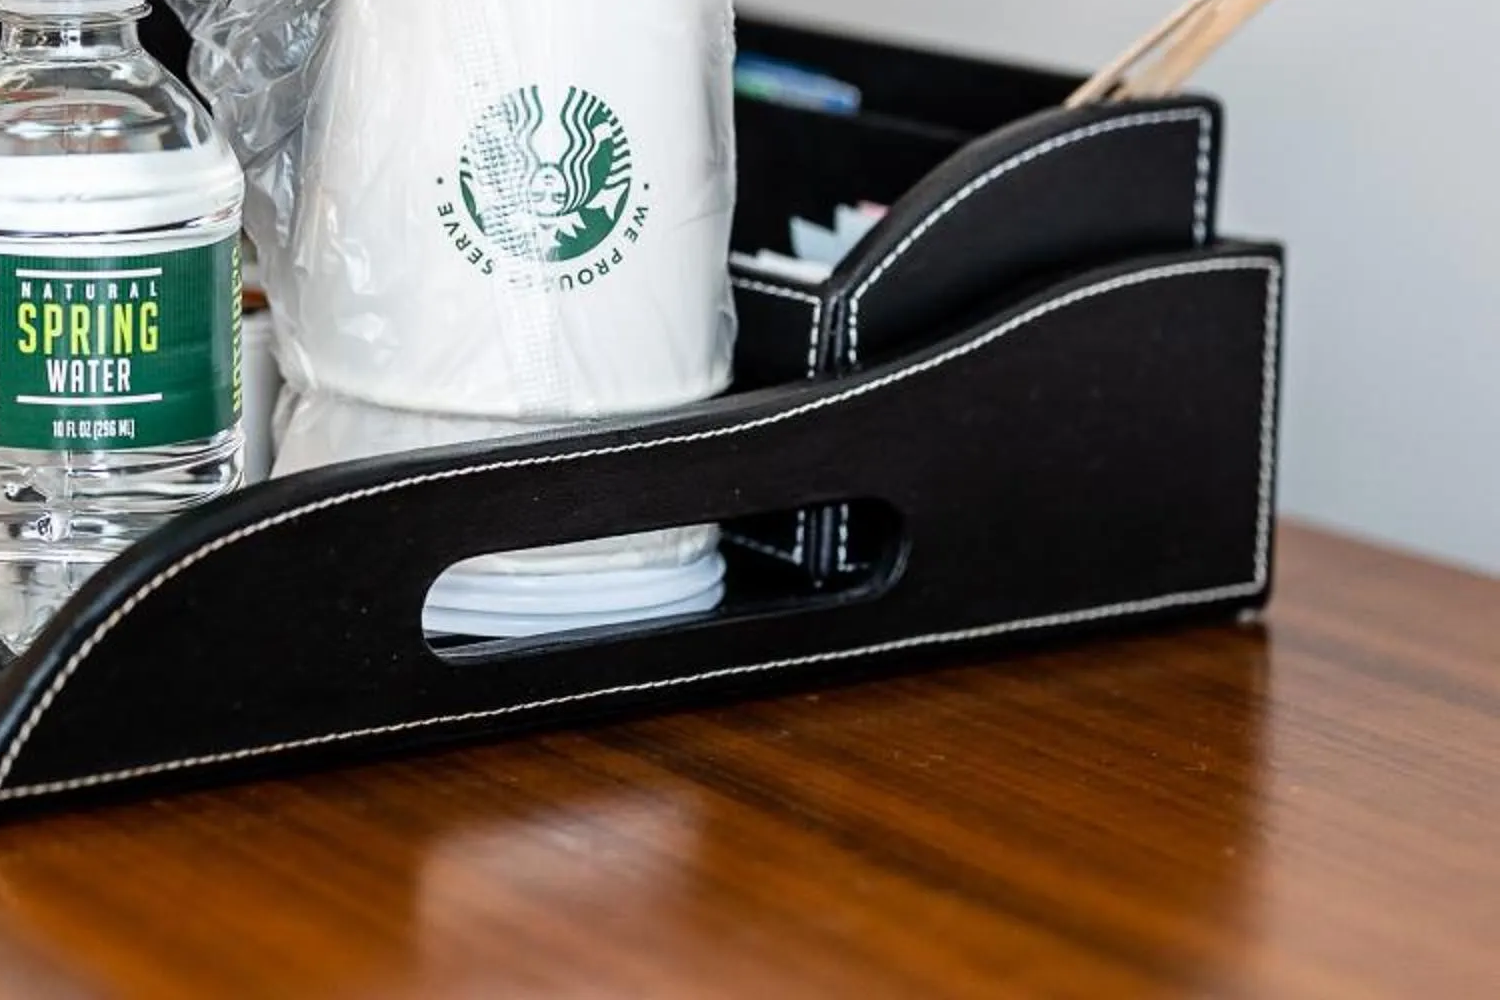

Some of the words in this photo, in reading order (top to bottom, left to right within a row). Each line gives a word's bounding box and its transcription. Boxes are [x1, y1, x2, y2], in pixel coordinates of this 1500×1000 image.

[437, 201, 495, 276] SERVE
[623, 205, 650, 243] WE
[20, 280, 158, 300] NATURAL
[17, 302, 160, 355] SPRING
[46, 358, 131, 393] WATER
[52, 420, 65, 438] 10
[65, 419, 77, 438] FL
[79, 419, 93, 438] OZ
